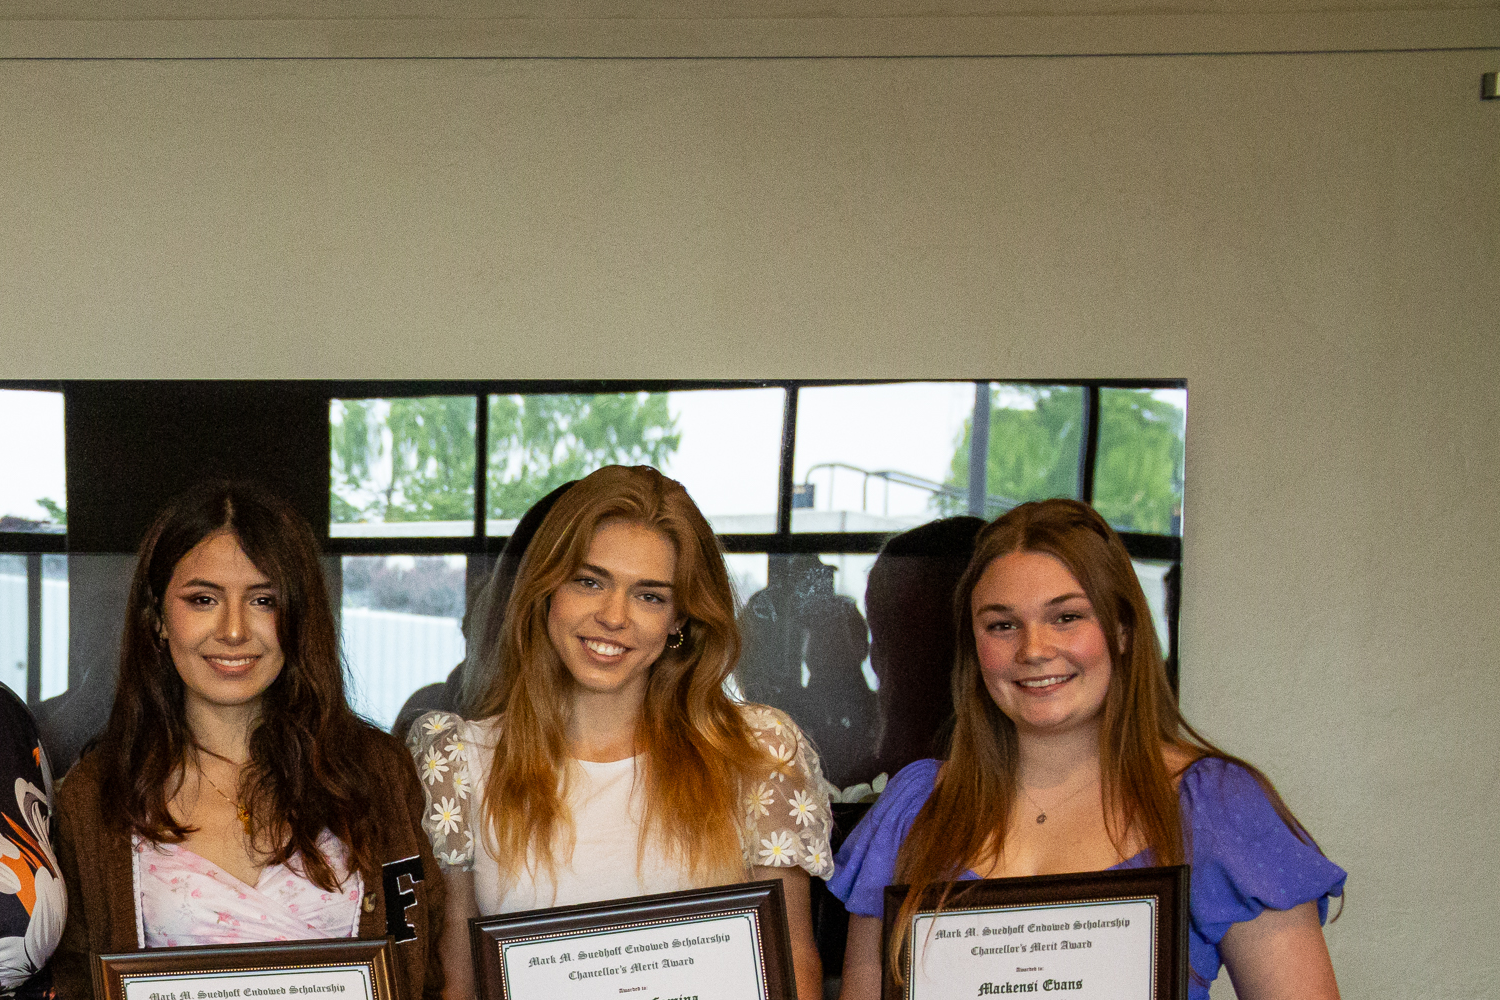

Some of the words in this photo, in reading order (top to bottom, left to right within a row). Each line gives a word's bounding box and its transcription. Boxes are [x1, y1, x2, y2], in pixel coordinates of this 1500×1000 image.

[935, 929, 961, 940] Mark
[964, 927, 978, 938] M.
[982, 924, 1024, 936] Suedhoff
[1027, 922, 1070, 933] Endowed
[1073, 917, 1130, 930] Scholarship
[528, 955, 556, 967] Mark
[559, 952, 574, 963] M.
[577, 946, 621, 960] Suedhoff
[624, 941, 668, 954] Endowed
[671, 933, 730, 948] Scholarship
[1029, 942, 1057, 953] Merit
[1060, 940, 1092, 950] Award
[630, 961, 658, 973] Merit
[661, 957, 694, 968] Award
[179, 991, 194, 1000] M.
[197, 988, 240, 999] Suedhoff
[243, 986, 286, 996] Endowed
[288, 983, 345, 995] Scholarship
[977, 980, 1038, 996] Mackensi
[1042, 978, 1083, 991] Evans
